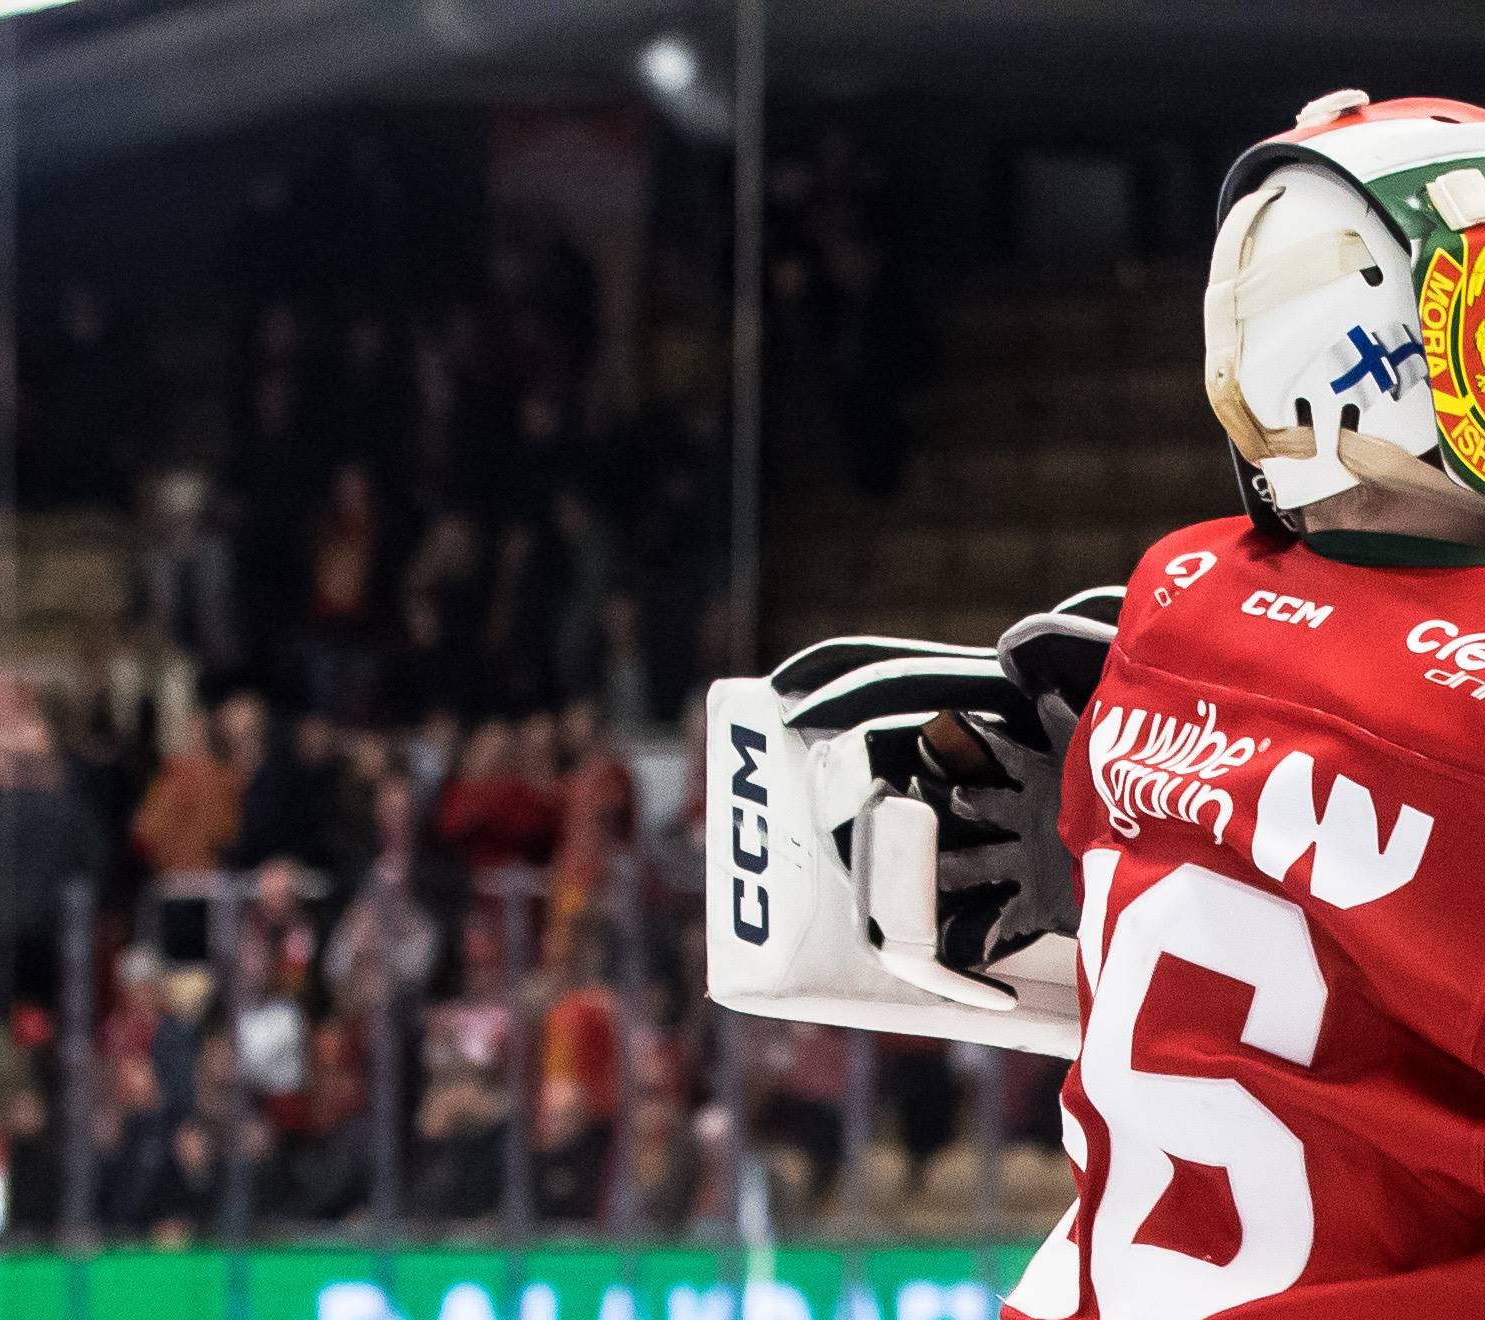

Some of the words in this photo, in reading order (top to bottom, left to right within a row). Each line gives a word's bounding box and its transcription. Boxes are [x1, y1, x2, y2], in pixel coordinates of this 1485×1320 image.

[1422, 272, 1455, 379] MORA
[1241, 589, 1334, 629] CCM
[729, 723, 770, 949] CCM
